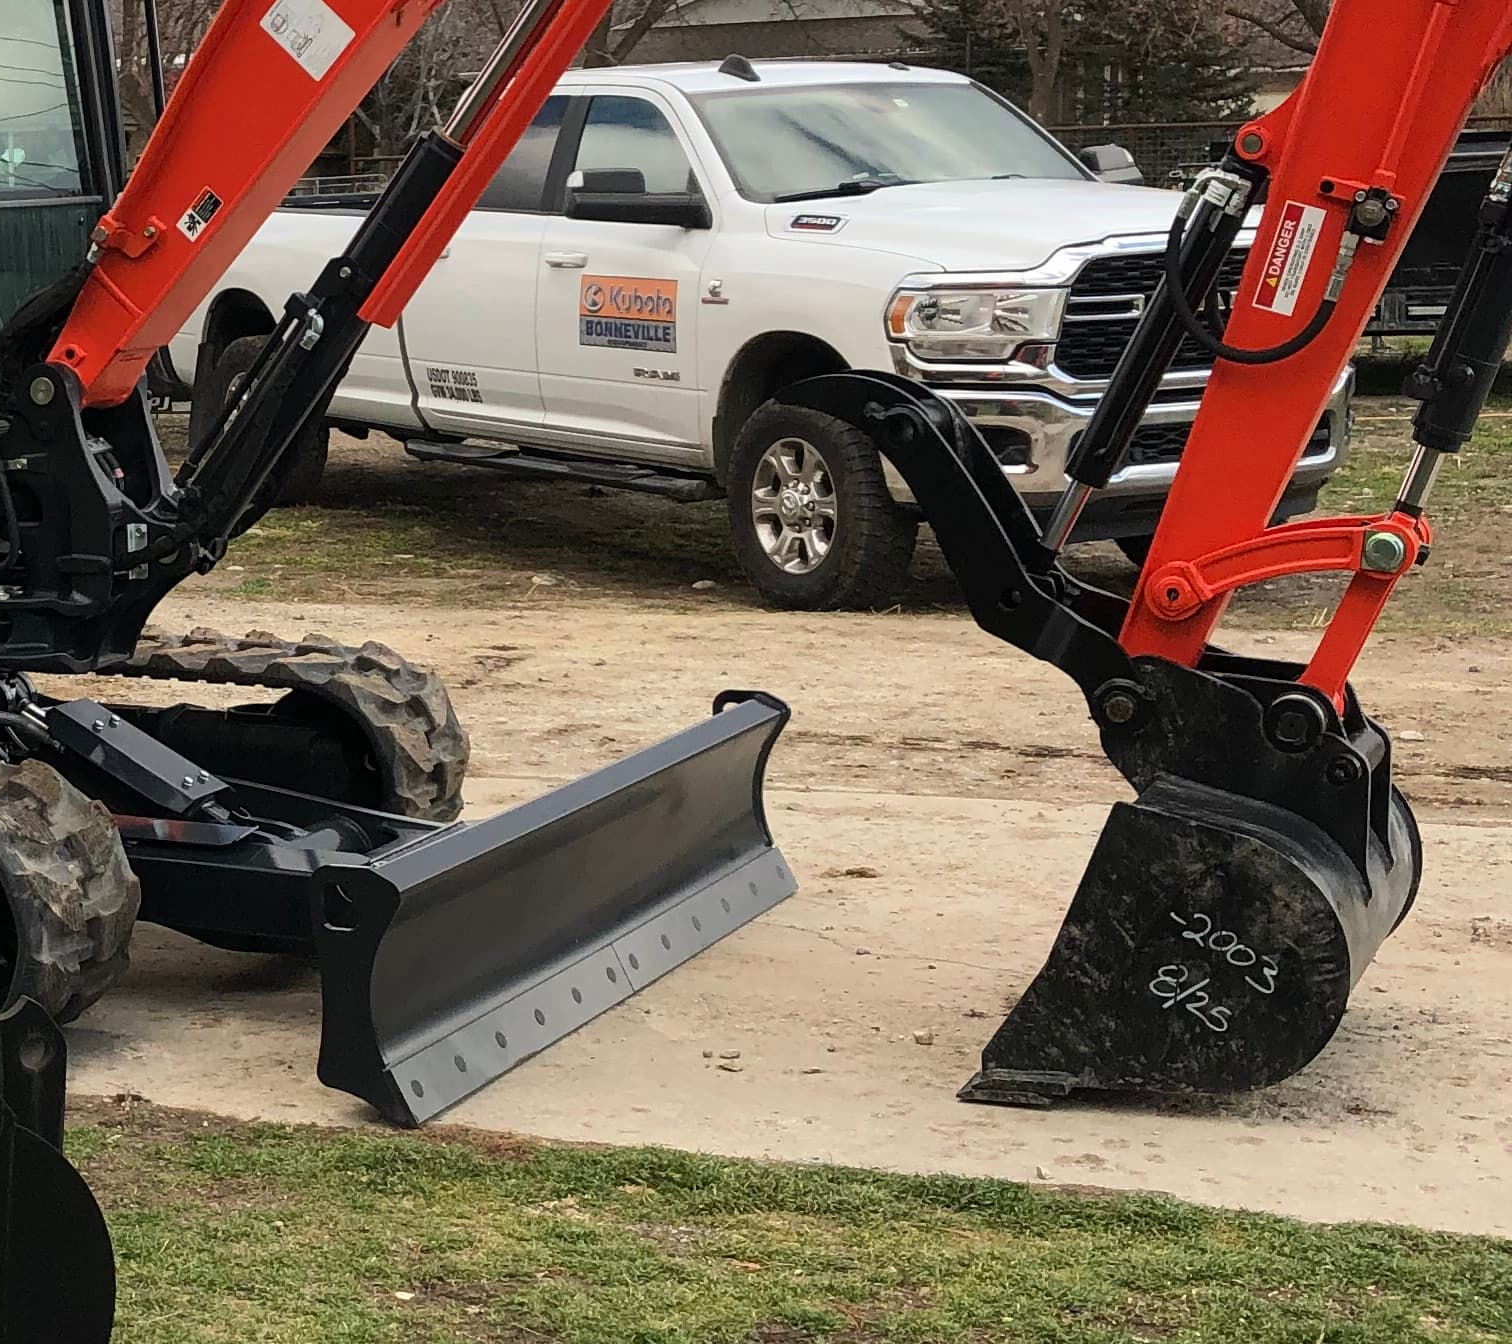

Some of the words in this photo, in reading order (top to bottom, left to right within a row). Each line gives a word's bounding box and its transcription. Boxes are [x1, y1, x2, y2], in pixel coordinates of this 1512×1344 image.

[797, 216, 838, 226] 3500
[1268, 219, 1297, 276] DANGER
[608, 284, 673, 315] Kubota
[585, 319, 672, 343] BONNEVILLE
[426, 367, 450, 384] USDOT
[633, 367, 680, 382] RAM
[1169, 911, 1279, 994] -2003
[1148, 964, 1233, 1032] 8/25
